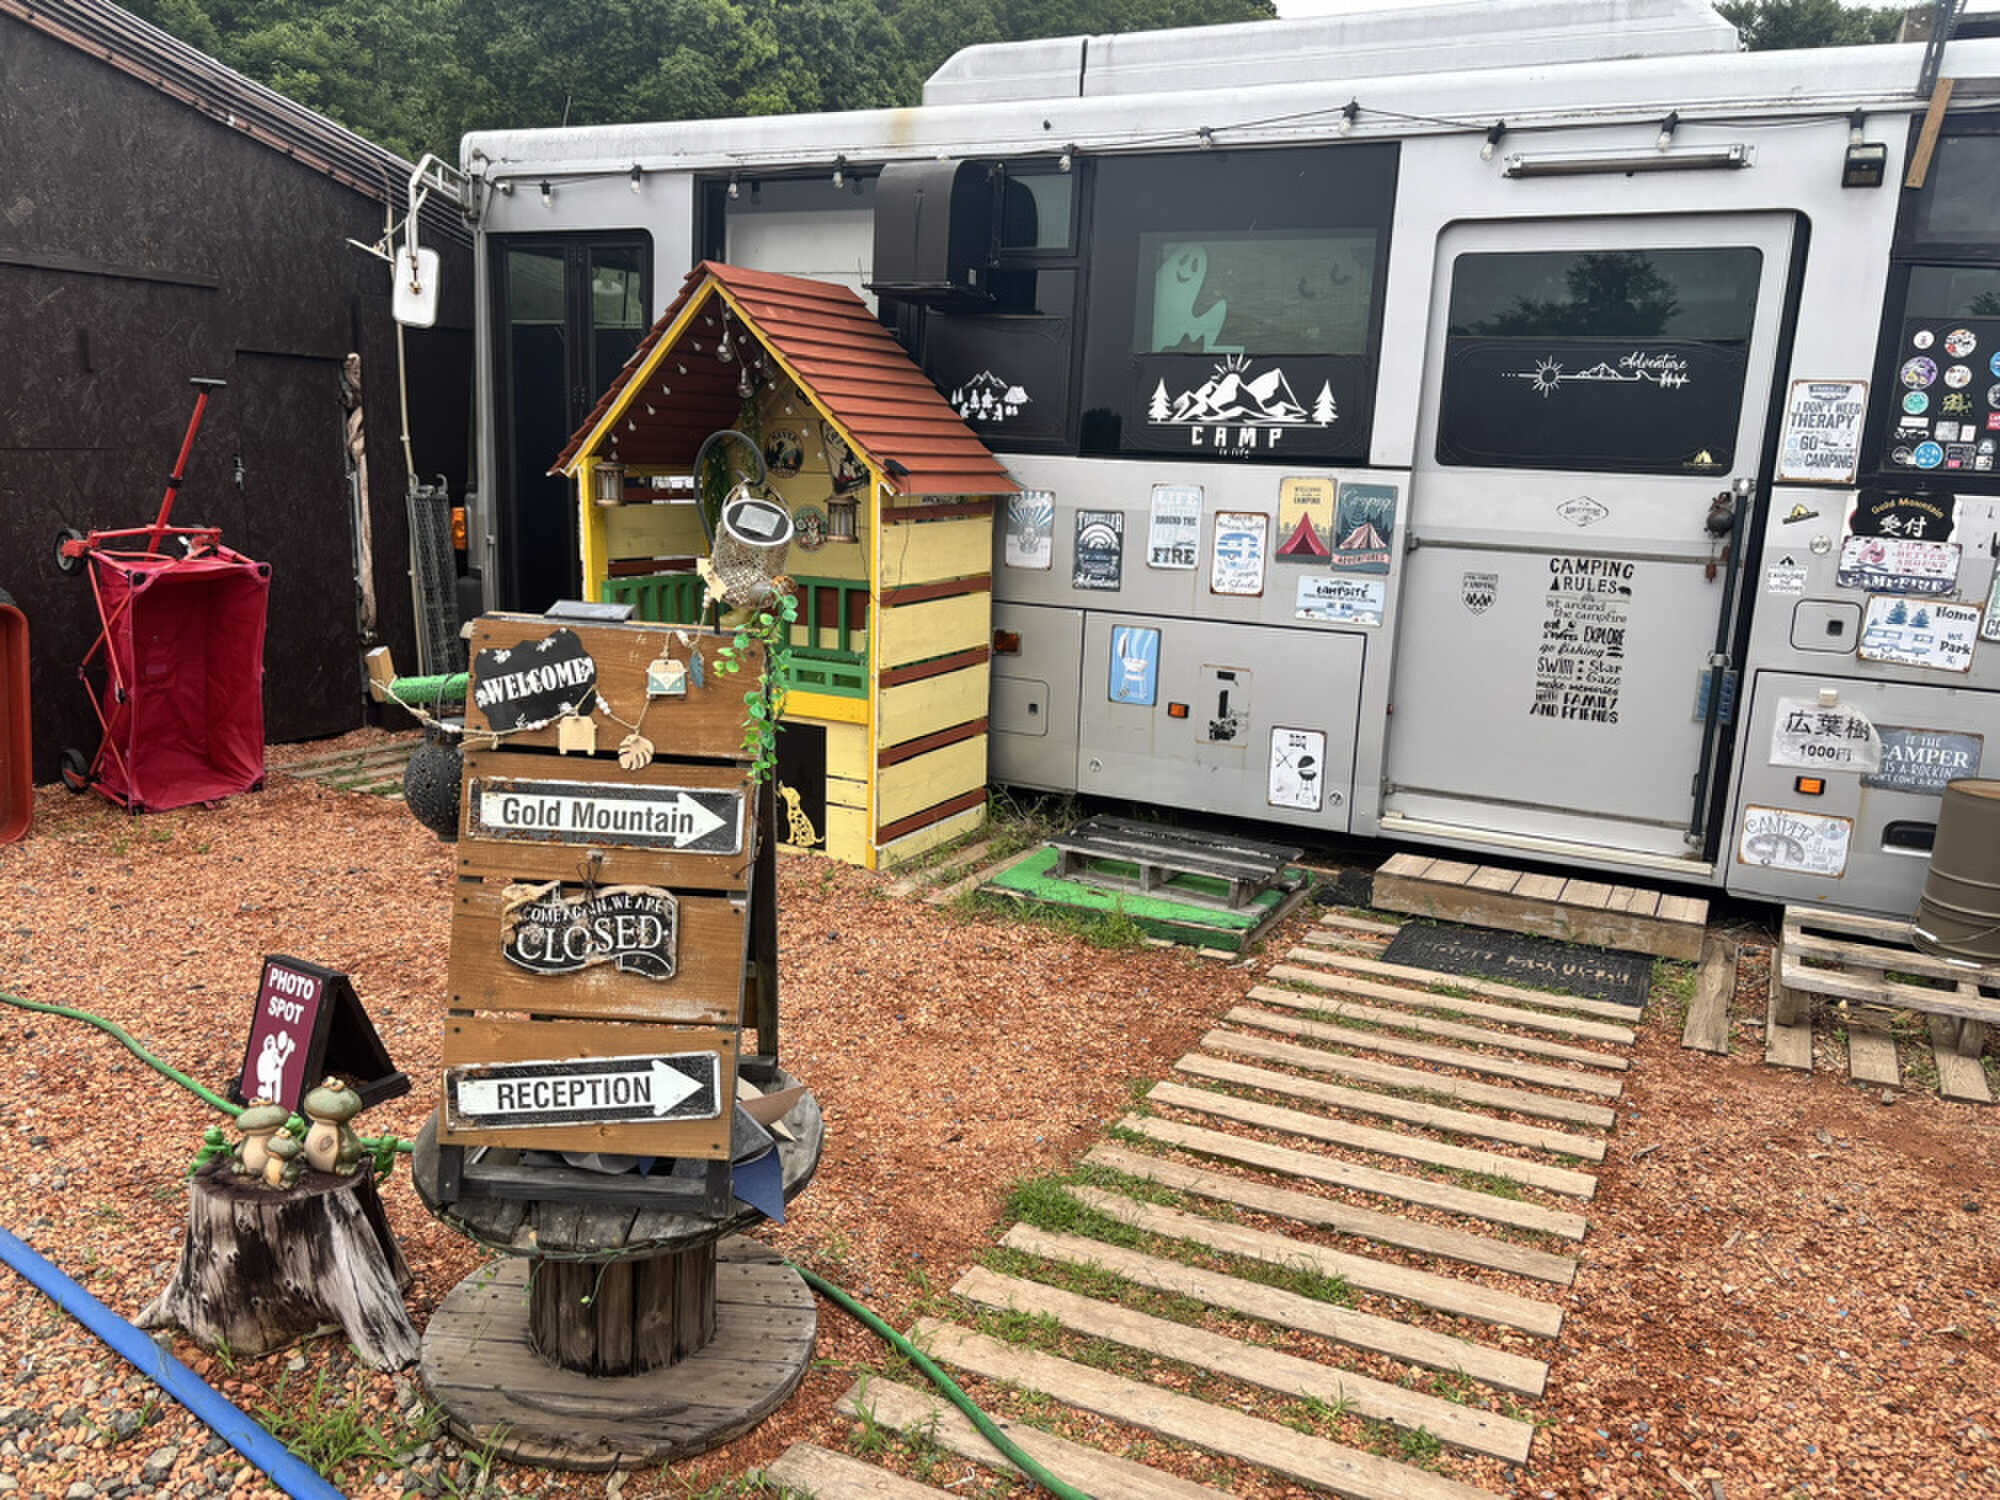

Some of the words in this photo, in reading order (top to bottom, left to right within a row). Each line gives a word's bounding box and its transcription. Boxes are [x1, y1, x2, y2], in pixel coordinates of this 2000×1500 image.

[1791, 413, 1856, 429] THERAPY
[1191, 426, 1283, 448] CAMP
[1800, 435, 1819, 451] GO
[1804, 453, 1854, 469] CAMPING
[1879, 513, 1928, 538] 受付
[1151, 546, 1195, 566] FIRE
[1549, 557, 1635, 580] CAMPING
[1563, 577, 1617, 594] RULES
[1935, 606, 1977, 622] Home
[1583, 625, 1626, 646] EXPLORE
[1557, 641, 1605, 658] fishing
[1939, 640, 1971, 656] Park
[1588, 660, 1623, 675] Star
[482, 657, 590, 705] WELCOME
[1536, 678, 1566, 690] make
[1585, 672, 1622, 686] Gaze
[1563, 691, 1619, 710] FAMILY
[1529, 703, 1559, 716] AND
[1561, 705, 1619, 724] FRIENDS
[1785, 708, 1871, 742] 広葉樹
[1799, 744, 1852, 763] 1000円
[502, 797, 560, 827] Gold
[571, 801, 694, 835] Mountain
[1744, 814, 1815, 843] CAMPER
[523, 906, 561, 924] COME
[612, 895, 633, 911] WE
[634, 896, 663, 914] ARE
[516, 914, 663, 963] CLOSED
[268, 967, 315, 1001] PHOTO
[267, 995, 305, 1025] SPOT
[497, 1076, 651, 1110] RECEPTION
